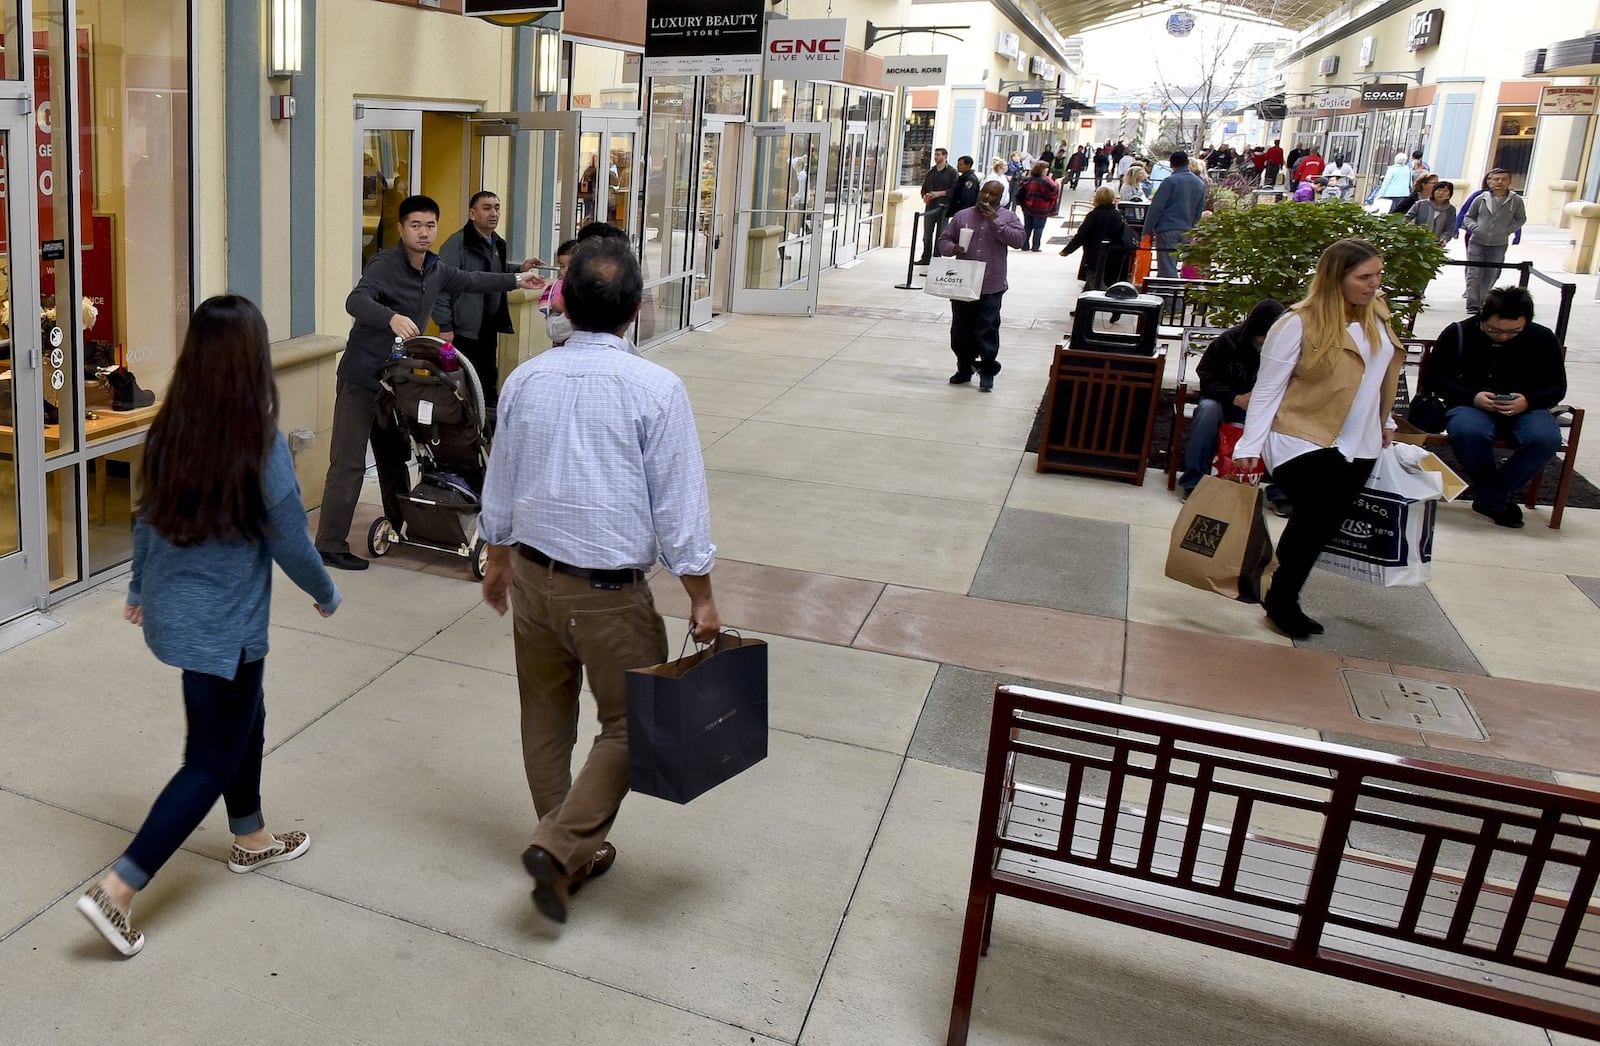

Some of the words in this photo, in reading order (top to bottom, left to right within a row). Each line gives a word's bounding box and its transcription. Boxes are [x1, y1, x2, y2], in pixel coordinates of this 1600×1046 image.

[651, 16, 702, 29] LUXURY
[706, 14, 758, 26] BEAUTY
[686, 29, 720, 37] STORE
[770, 39, 841, 53] GNC
[805, 53, 840, 61] WELL
[1320, 98, 1350, 107] Justice
[1341, 518, 1372, 535] ass
[1185, 528, 1218, 550] BANK
